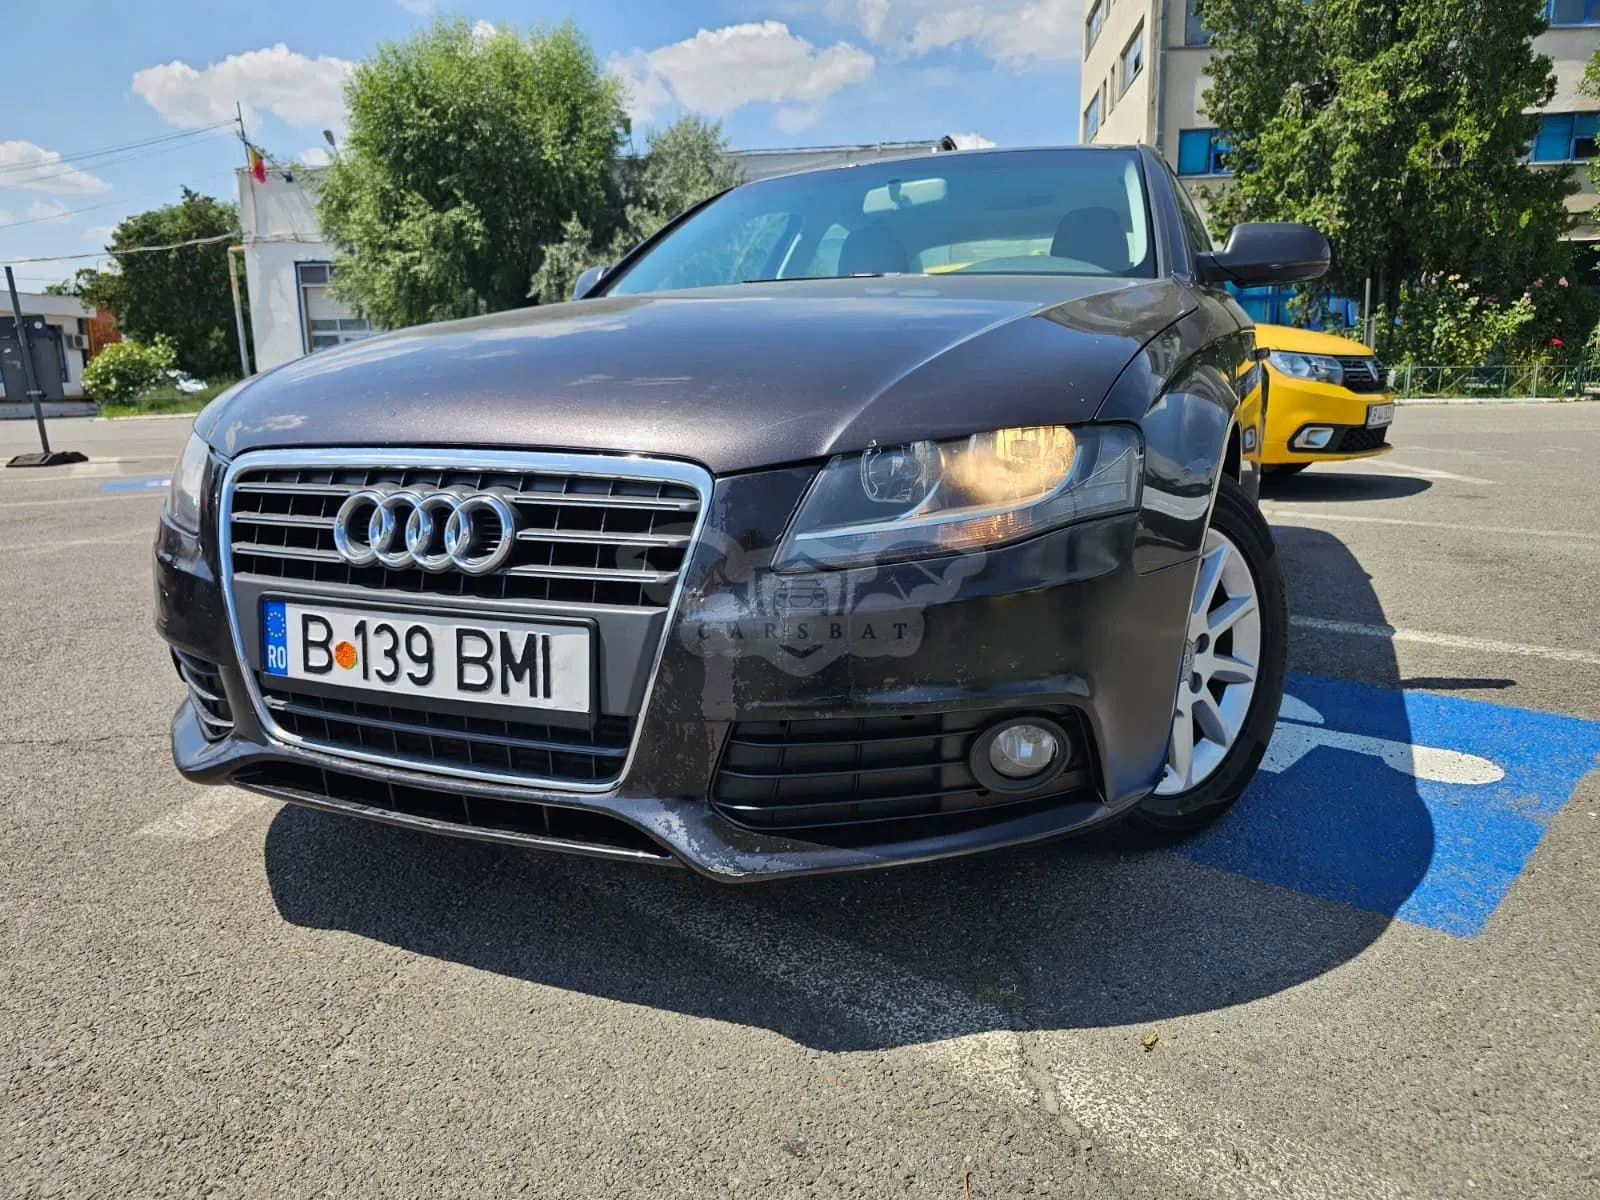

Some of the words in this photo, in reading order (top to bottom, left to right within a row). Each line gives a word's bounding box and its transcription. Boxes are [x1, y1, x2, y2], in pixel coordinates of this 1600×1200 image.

[267, 645, 288, 670] RO
[301, 613, 334, 674] B
[354, 619, 434, 686] 139
[455, 627, 552, 699] BMI
